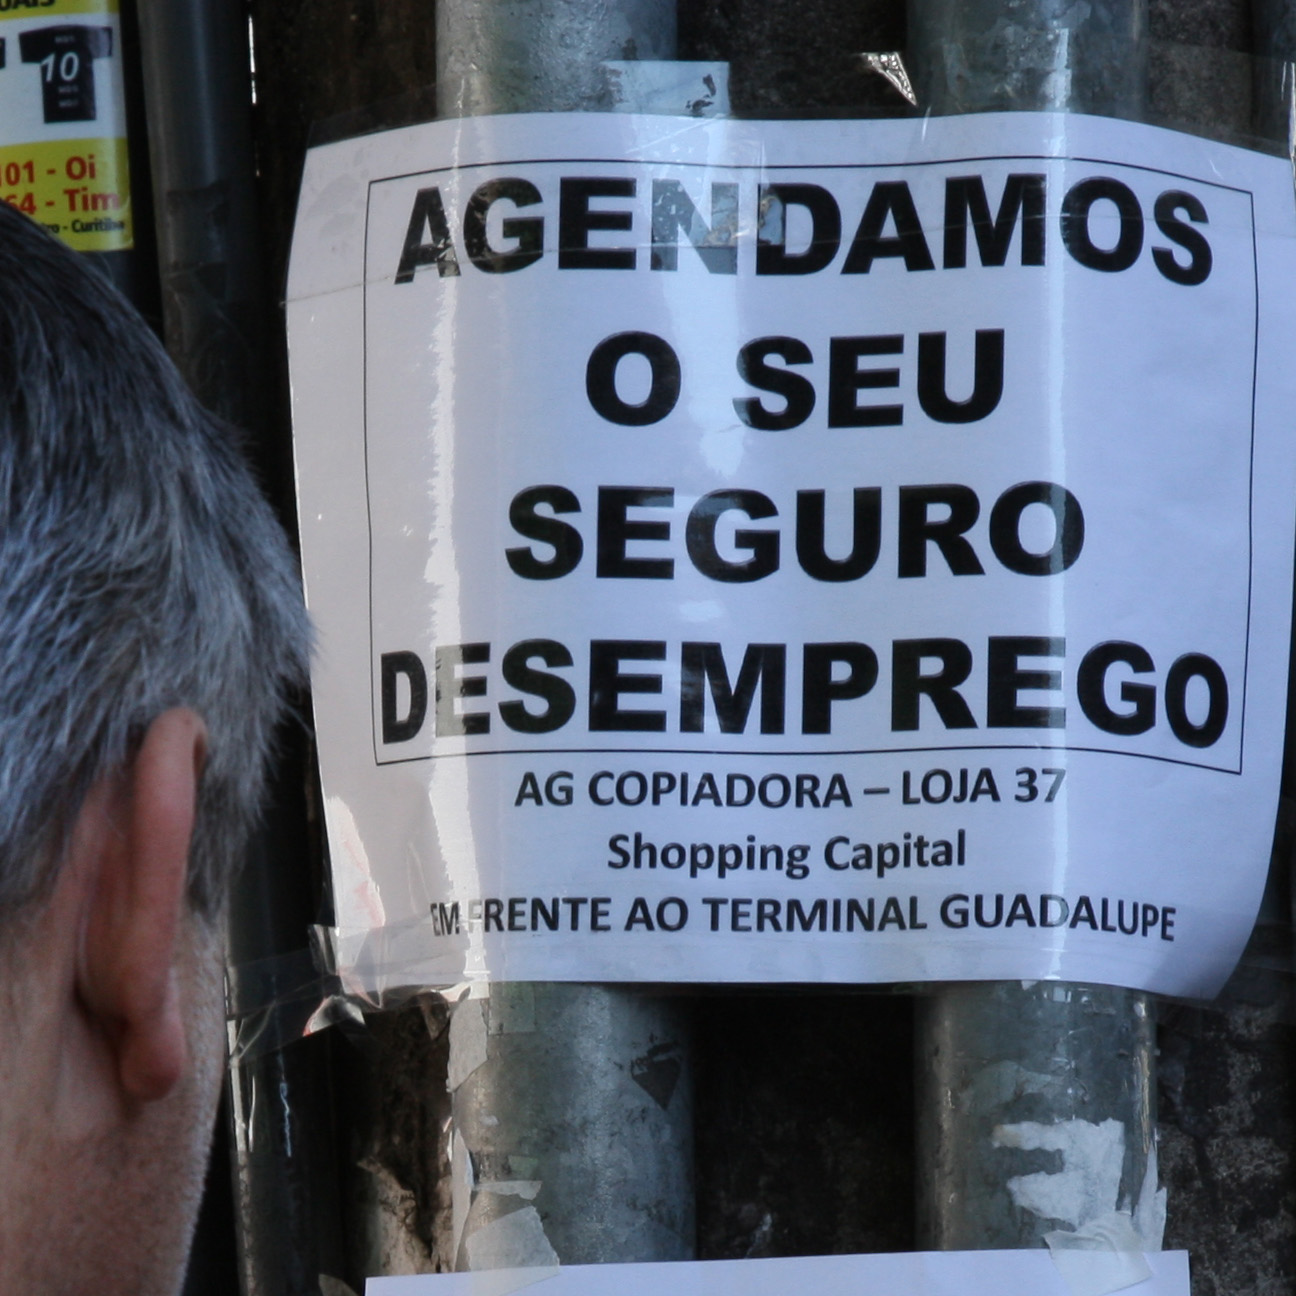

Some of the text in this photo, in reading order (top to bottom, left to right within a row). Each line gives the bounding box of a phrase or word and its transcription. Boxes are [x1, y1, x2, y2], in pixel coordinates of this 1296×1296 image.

[41, 52, 79, 82] 10
[65, 154, 96, 180] Oi
[64, 187, 120, 212] Tim
[394, 173, 1212, 286] AGENDAMOS
[585, 328, 1004, 431] O SEU
[505, 480, 1085, 582] SEGURO
[380, 637, 1230, 750] DESEMPREGO
[514, 770, 574, 807] AG
[588, 770, 853, 809] COPIADORA
[902, 767, 1001, 806] LOJA
[1014, 767, 1066, 803] 37
[607, 828, 966, 880] Shopping Capital
[467, 897, 612, 933] FRENTE
[623, 896, 689, 933] AO
[701, 895, 928, 933] TERMINAL
[940, 893, 1177, 942] GUADALUPE
